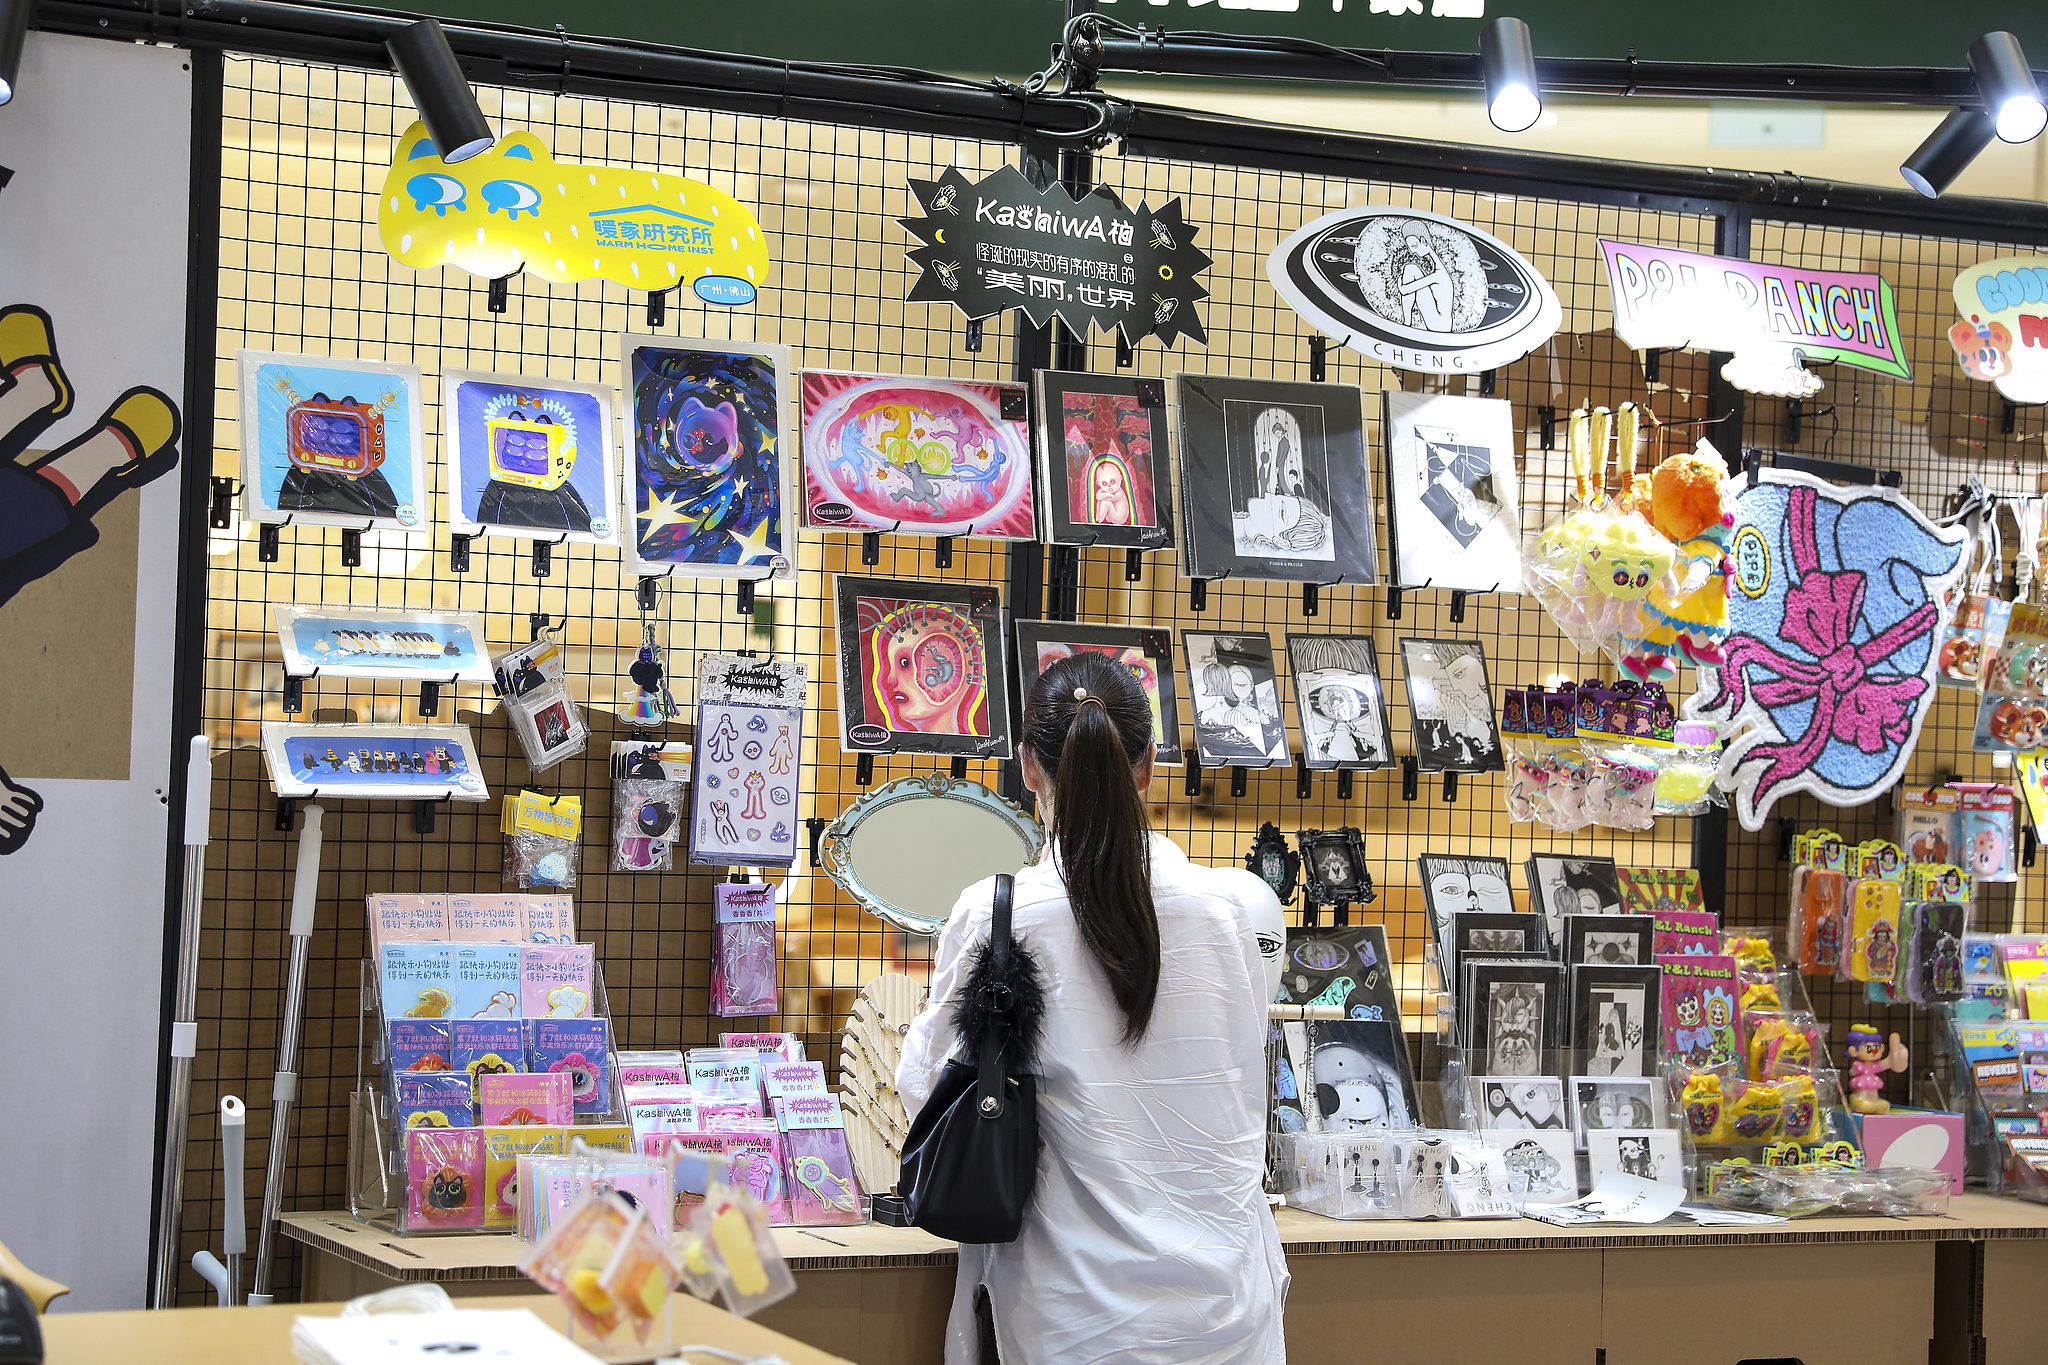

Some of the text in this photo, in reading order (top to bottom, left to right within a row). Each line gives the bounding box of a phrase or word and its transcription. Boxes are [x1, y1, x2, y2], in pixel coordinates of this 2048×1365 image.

[593, 219, 713, 247] 暖家研究所
[595, 238, 715, 255] WARM HOME INST
[976, 242, 1135, 286] 怪诞的现实的有序的混乱的
[1373, 342, 1464, 369] CHENG
[523, 806, 575, 829] 万物皆可夹
[1913, 815, 1938, 825] HELLO
[1654, 920, 1713, 936] &L Ranch
[1662, 963, 1733, 980] P&L Ranch
[1347, 1144, 1377, 1152] CHENG
[1413, 1147, 1442, 1155] CHENG
[1467, 1202, 1513, 1214] CHENG
